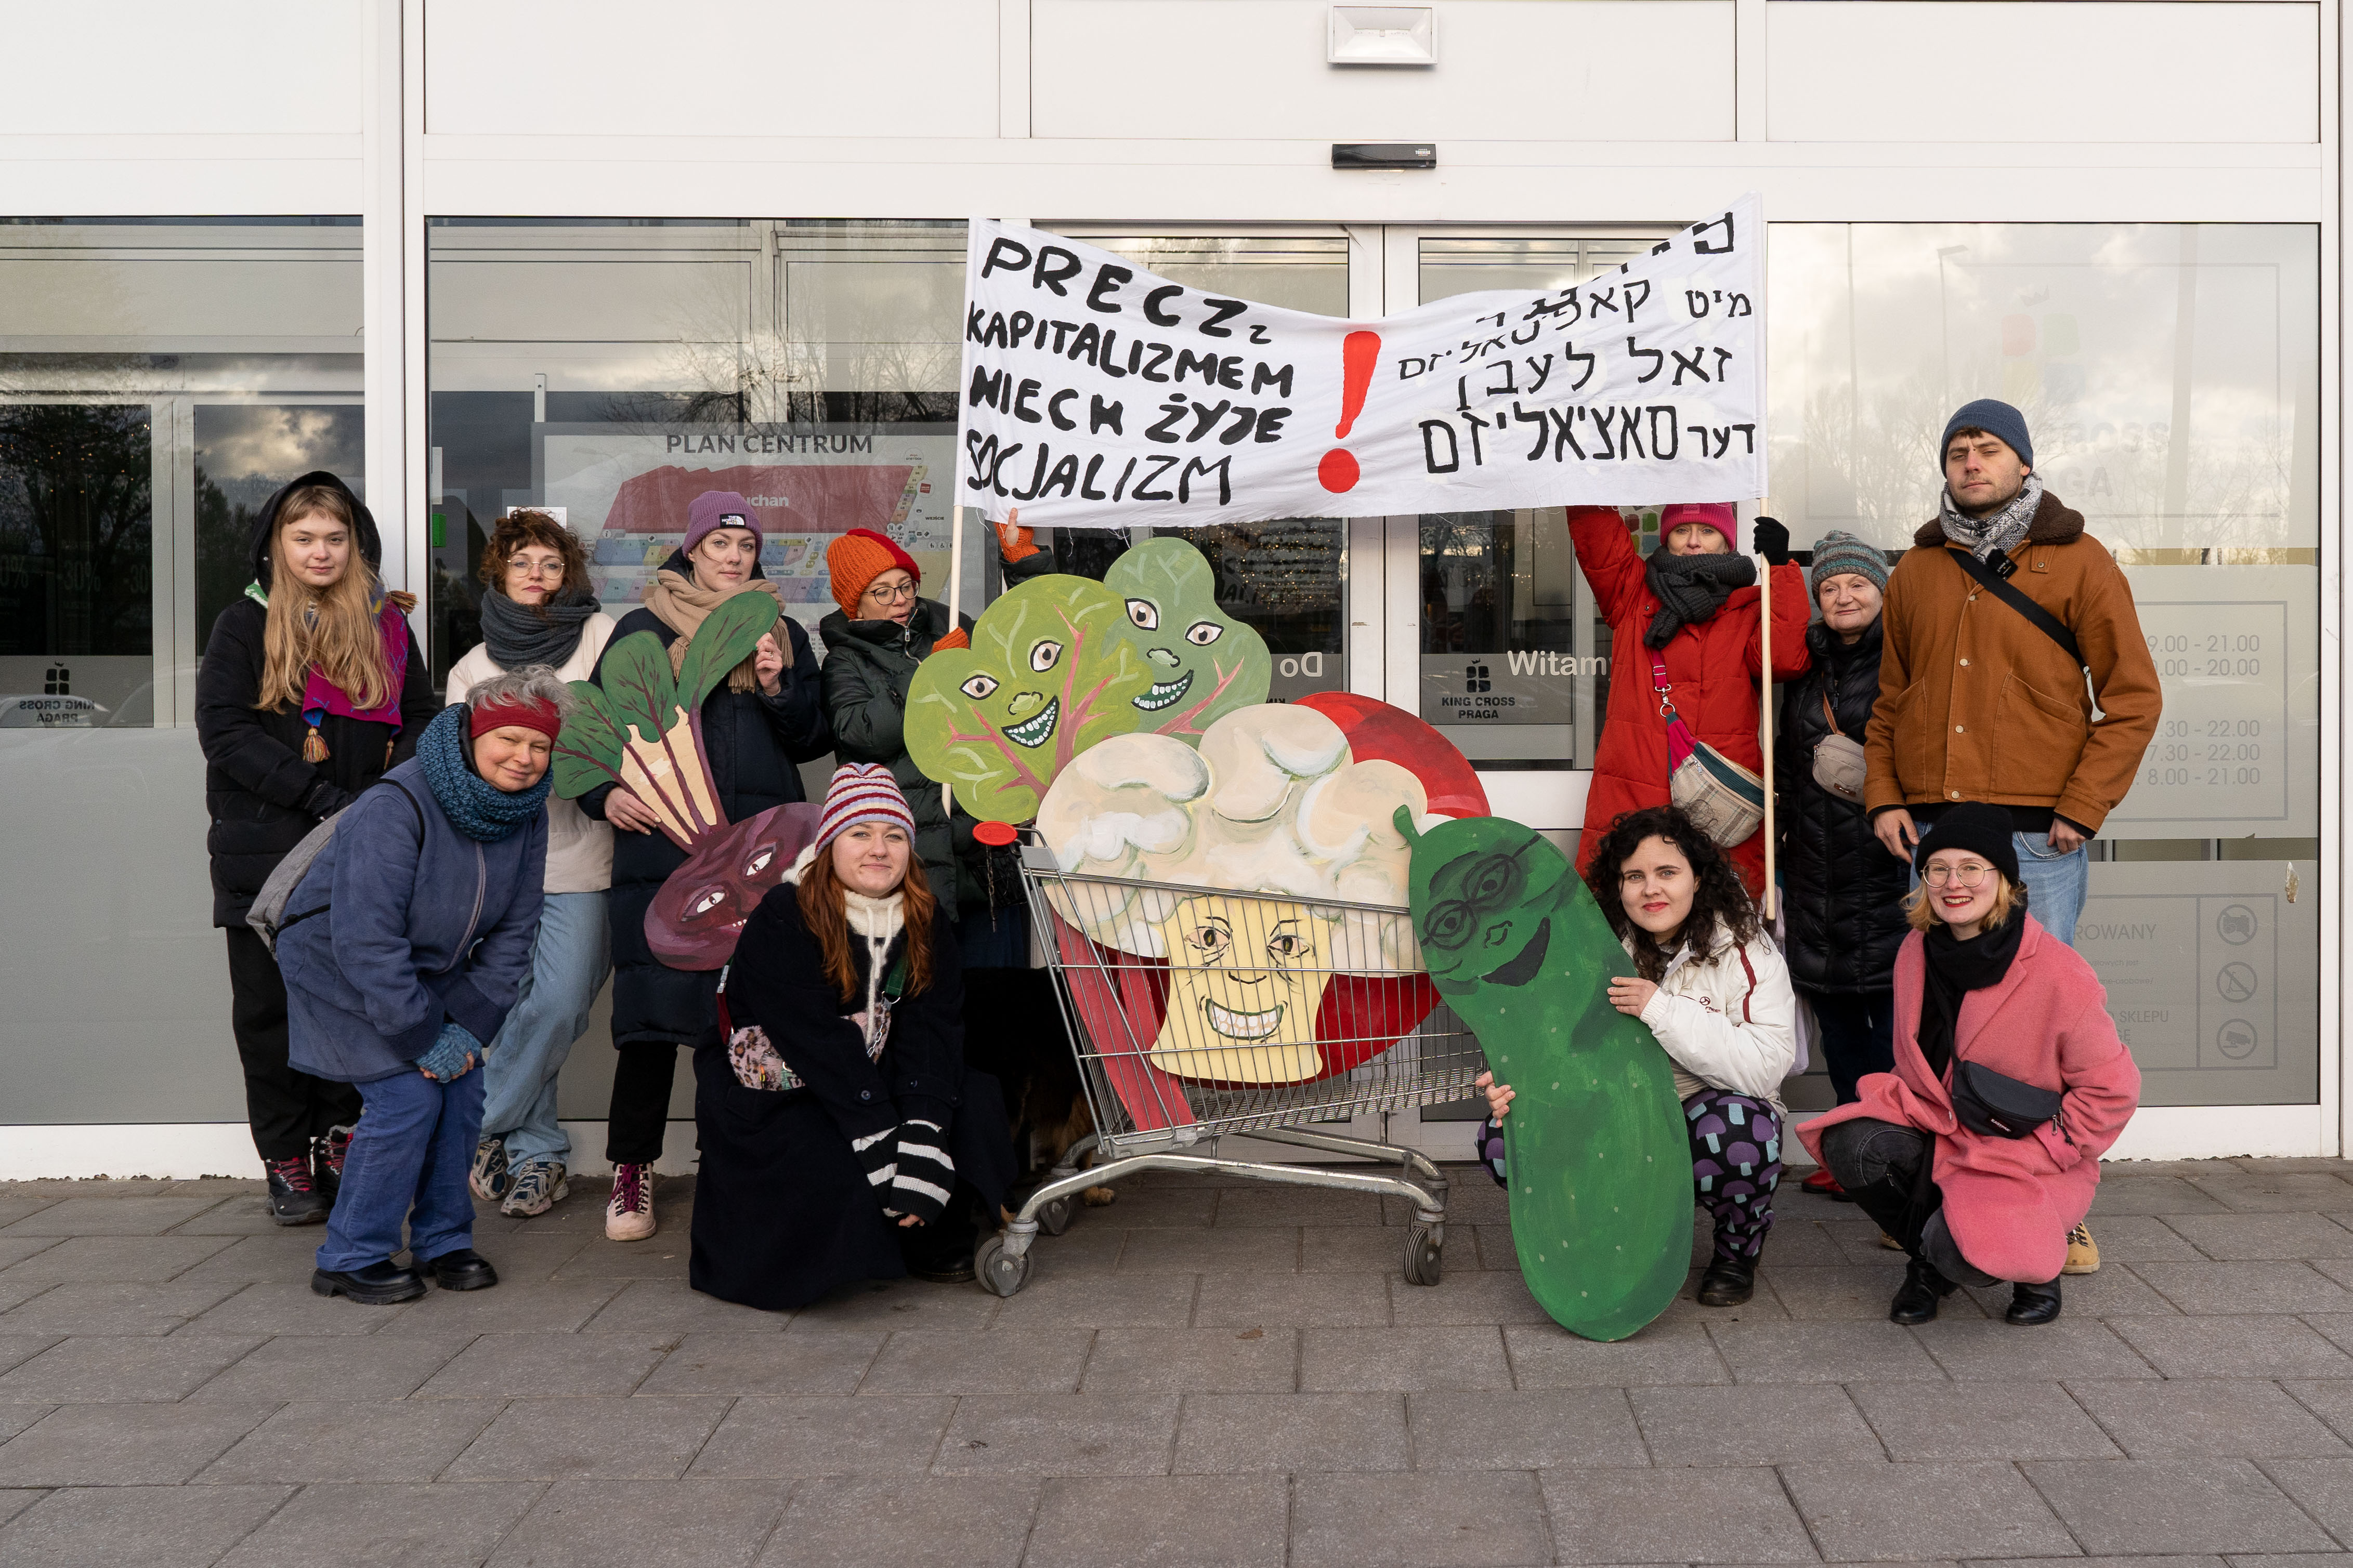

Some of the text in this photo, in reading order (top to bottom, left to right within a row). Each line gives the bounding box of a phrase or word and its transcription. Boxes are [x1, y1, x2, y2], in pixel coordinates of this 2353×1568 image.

[982, 237, 1248, 337] PRECZ
[1685, 289, 1752, 319] מיט
[966, 300, 1293, 398] KAPITALIZMEM
[1456, 336, 1733, 412] זאל לעבן
[970, 365, 1292, 443] NIECH ŻYJE
[666, 434, 872, 454] PLAN CENTRUM
[1688, 424, 1755, 459] דער
[966, 429, 1231, 506] SOCJALIZM
[746, 494, 789, 507] chan
[2207, 635, 2260, 652] 21.00
[1507, 650, 1612, 681] Witam
[2207, 658, 2260, 676] 20.00
[1442, 697, 1515, 706] KING CROSS
[1459, 710, 1499, 719] PRAGA
[2207, 720, 2260, 737] 22.00
[2207, 744, 2260, 761] 22.00
[2148, 768, 2188, 785] 8.00
[2207, 768, 2260, 785] 21.00
[2120, 1010, 2169, 1023] SKLEPU
